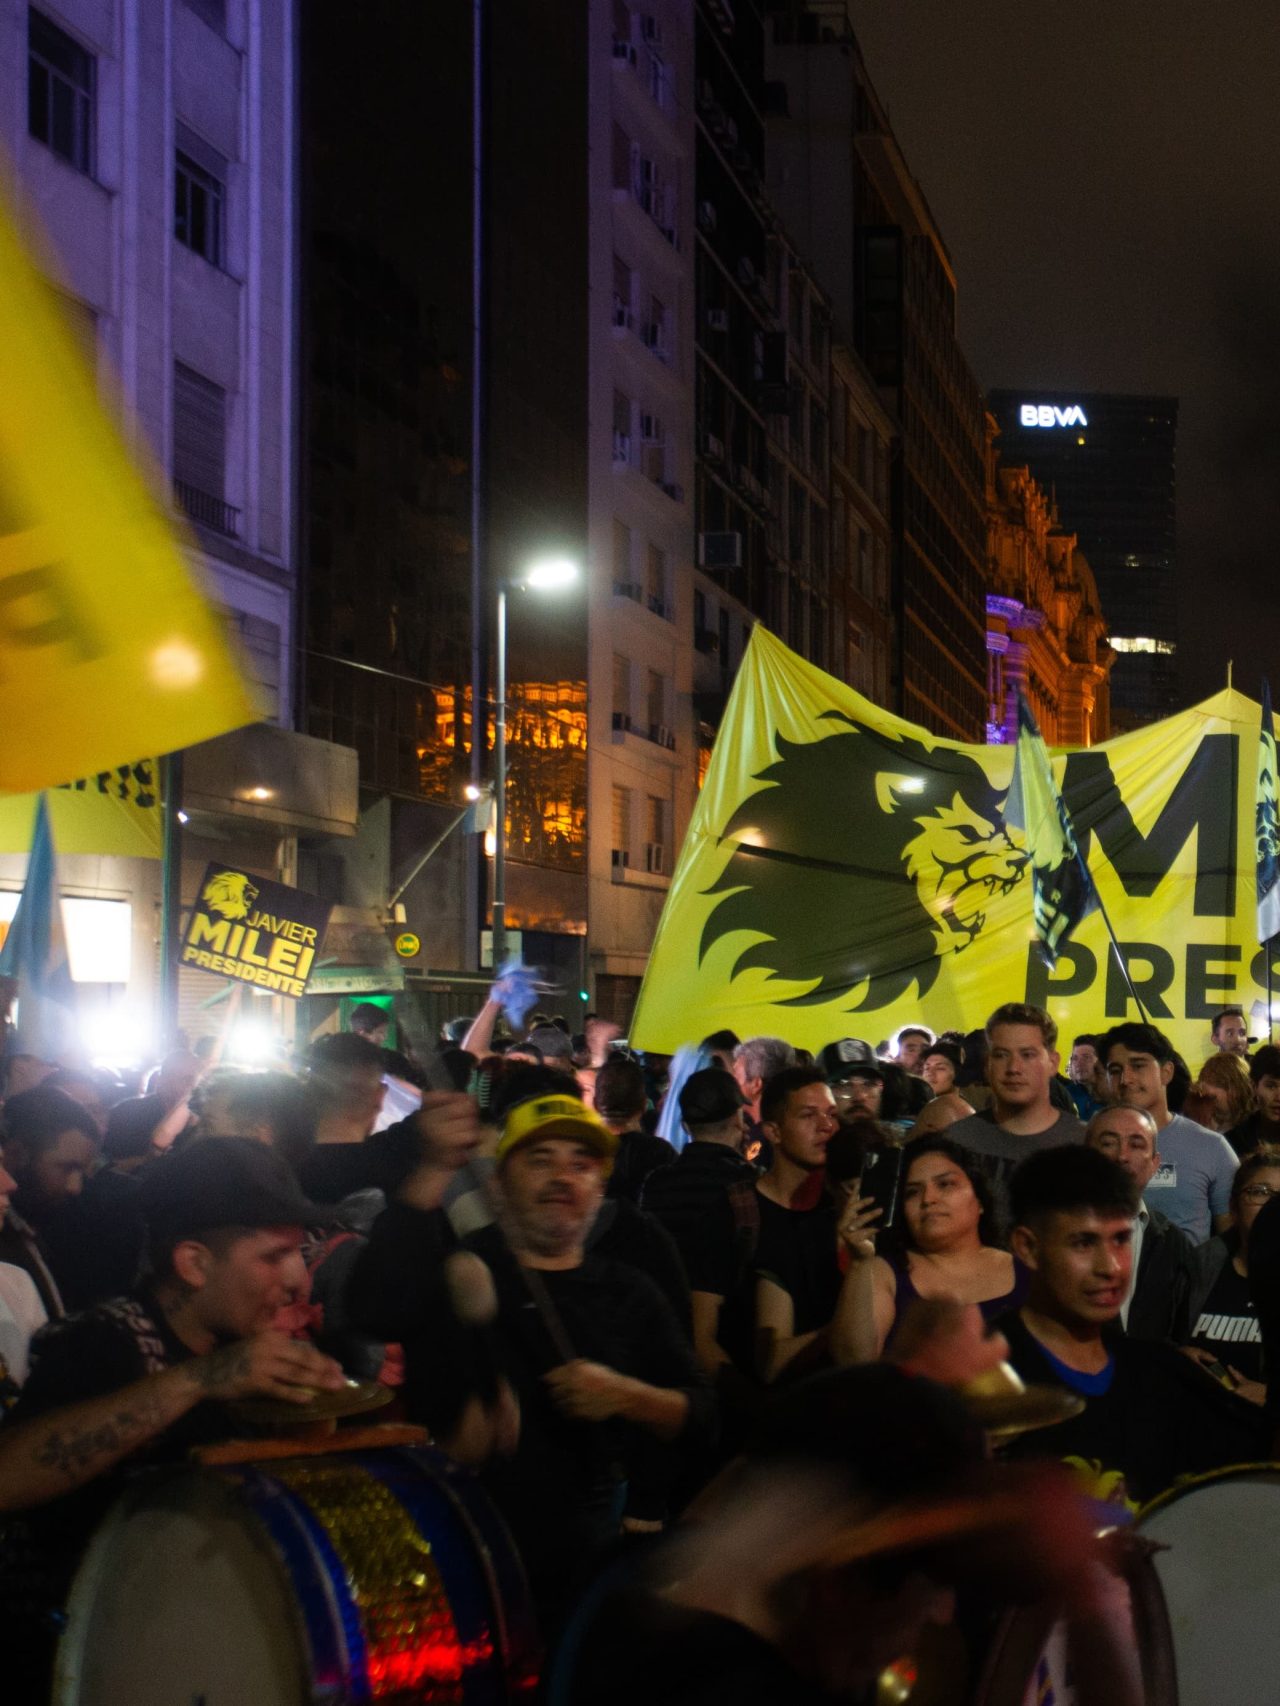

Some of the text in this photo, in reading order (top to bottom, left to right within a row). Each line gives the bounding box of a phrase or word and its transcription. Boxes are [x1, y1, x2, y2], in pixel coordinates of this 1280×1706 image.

[1020, 404, 1087, 427] BBVA
[188, 911, 315, 980] MILEI
[246, 910, 318, 946] JAVIER
[183, 945, 306, 998] PRESIDENTE
[1191, 1313, 1263, 1343] PUMA
